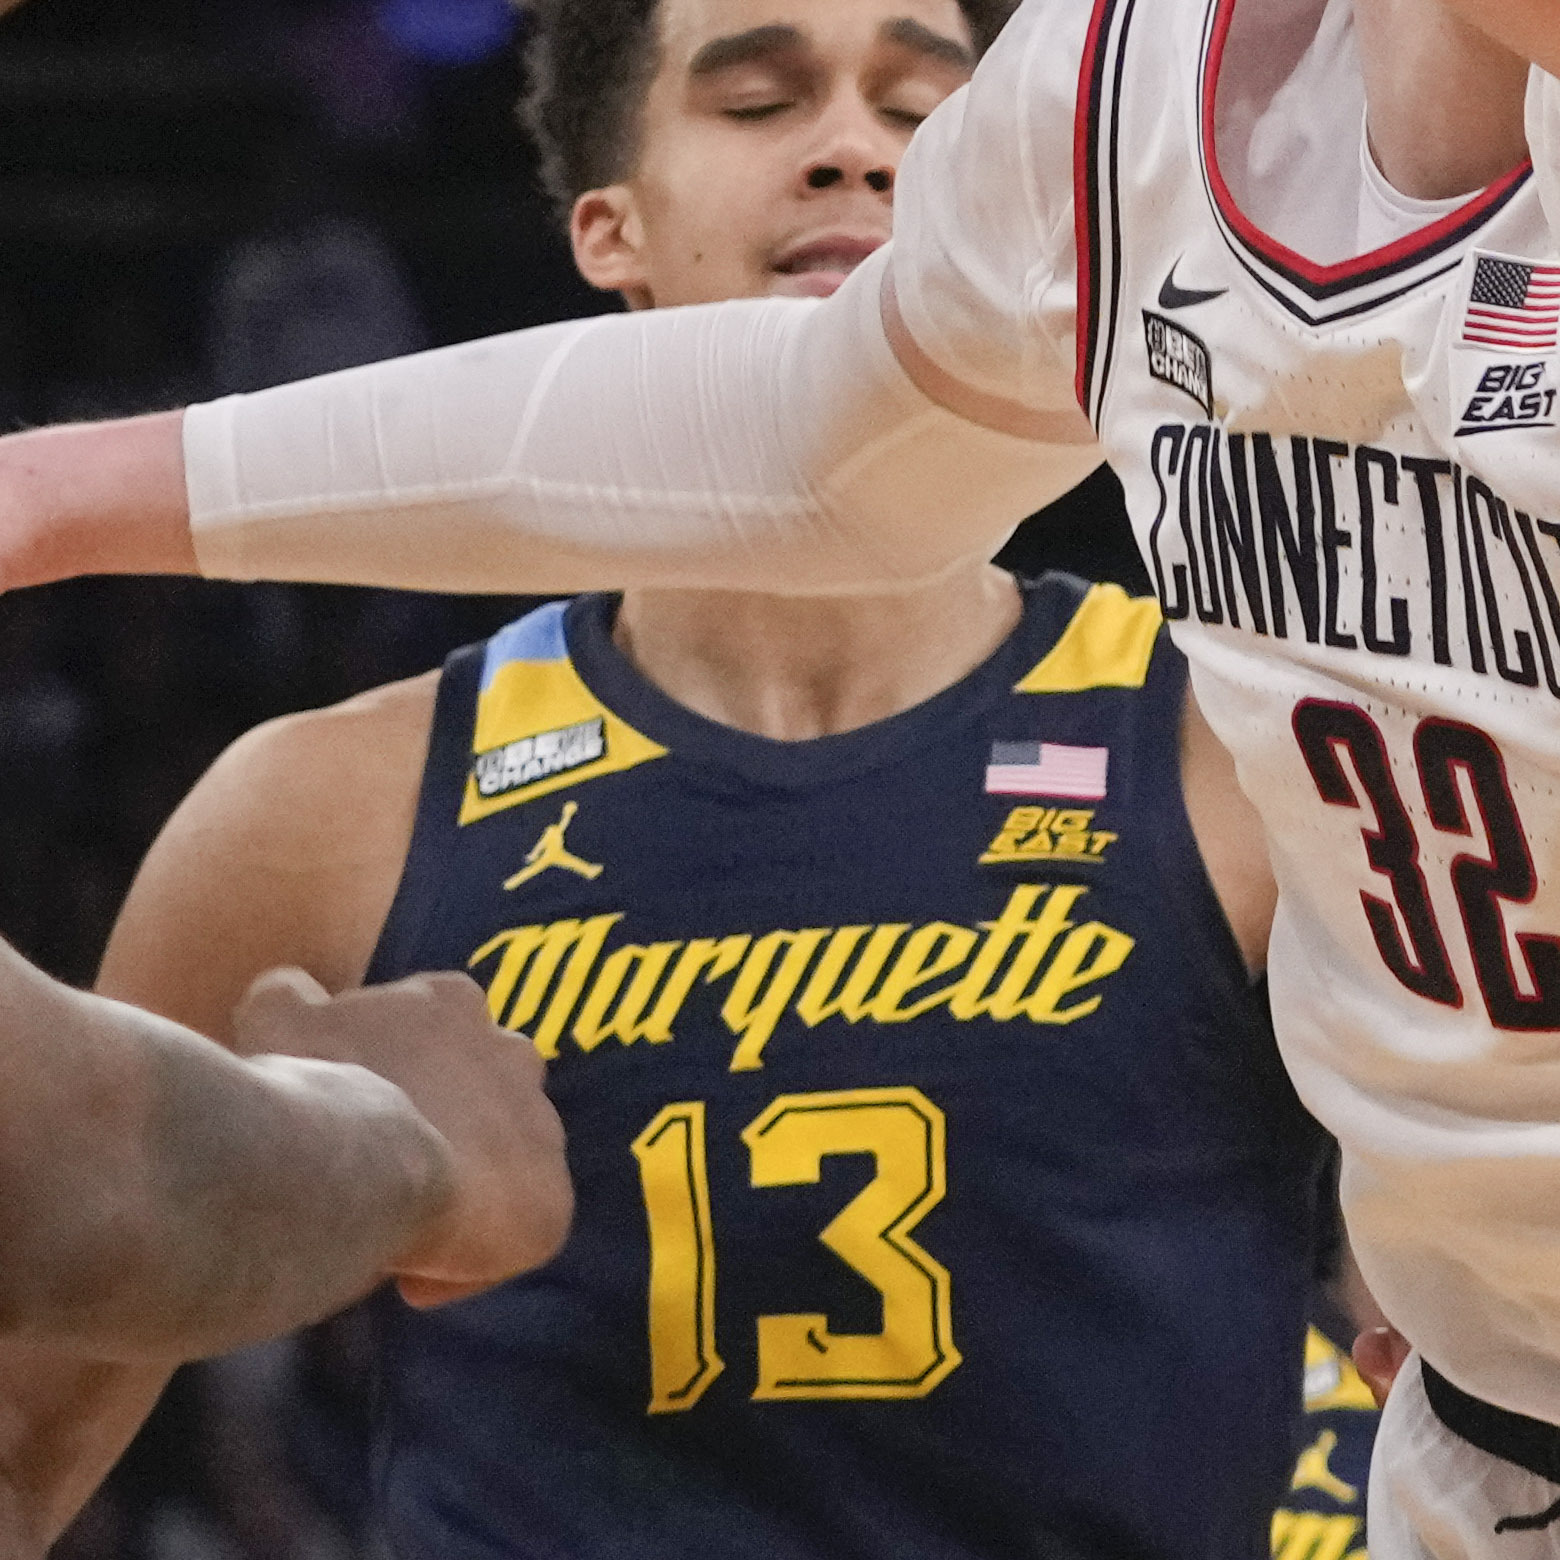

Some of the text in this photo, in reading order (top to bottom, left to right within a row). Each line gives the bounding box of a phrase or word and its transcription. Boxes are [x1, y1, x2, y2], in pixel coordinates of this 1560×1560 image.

[1151, 350, 1209, 407] CHAN
[1476, 361, 1545, 392] BIG
[1462, 388, 1557, 421] EAST
[479, 736, 604, 795] CHANGE
[1002, 806, 1095, 833] BIG
[989, 830, 1119, 855] EAST
[469, 884, 1135, 1072] Marquette
[631, 1086, 963, 1414] 13
